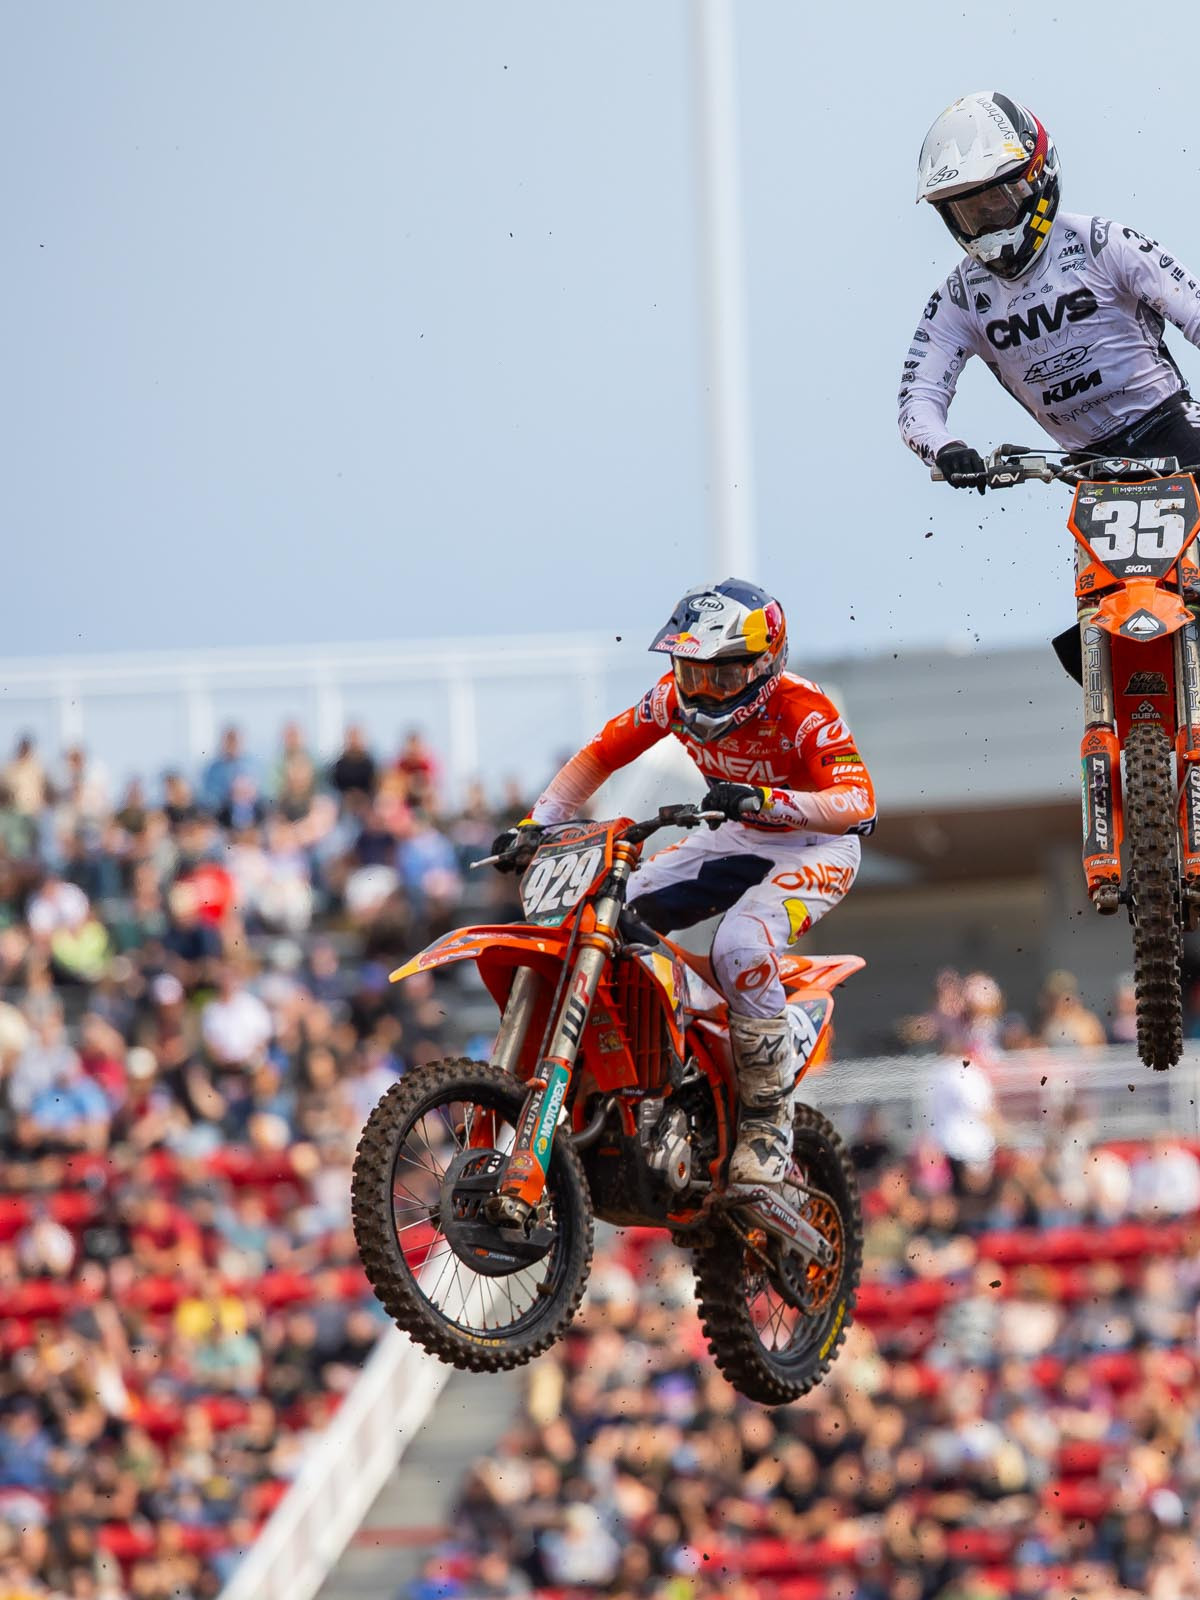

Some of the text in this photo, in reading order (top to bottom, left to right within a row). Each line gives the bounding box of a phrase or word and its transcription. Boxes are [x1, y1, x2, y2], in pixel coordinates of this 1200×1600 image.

[985, 287, 1099, 350] CNVS
[1042, 368, 1103, 406] KTM
[990, 471, 1020, 484] ASV
[1089, 498, 1186, 561] 35
[1124, 564, 1152, 574] SKDA
[1131, 712, 1161, 720] DUBYA
[523, 847, 602, 918] 929
[523, 1066, 551, 1137] DUNLP
[540, 1078, 568, 1139] MOTOREX
